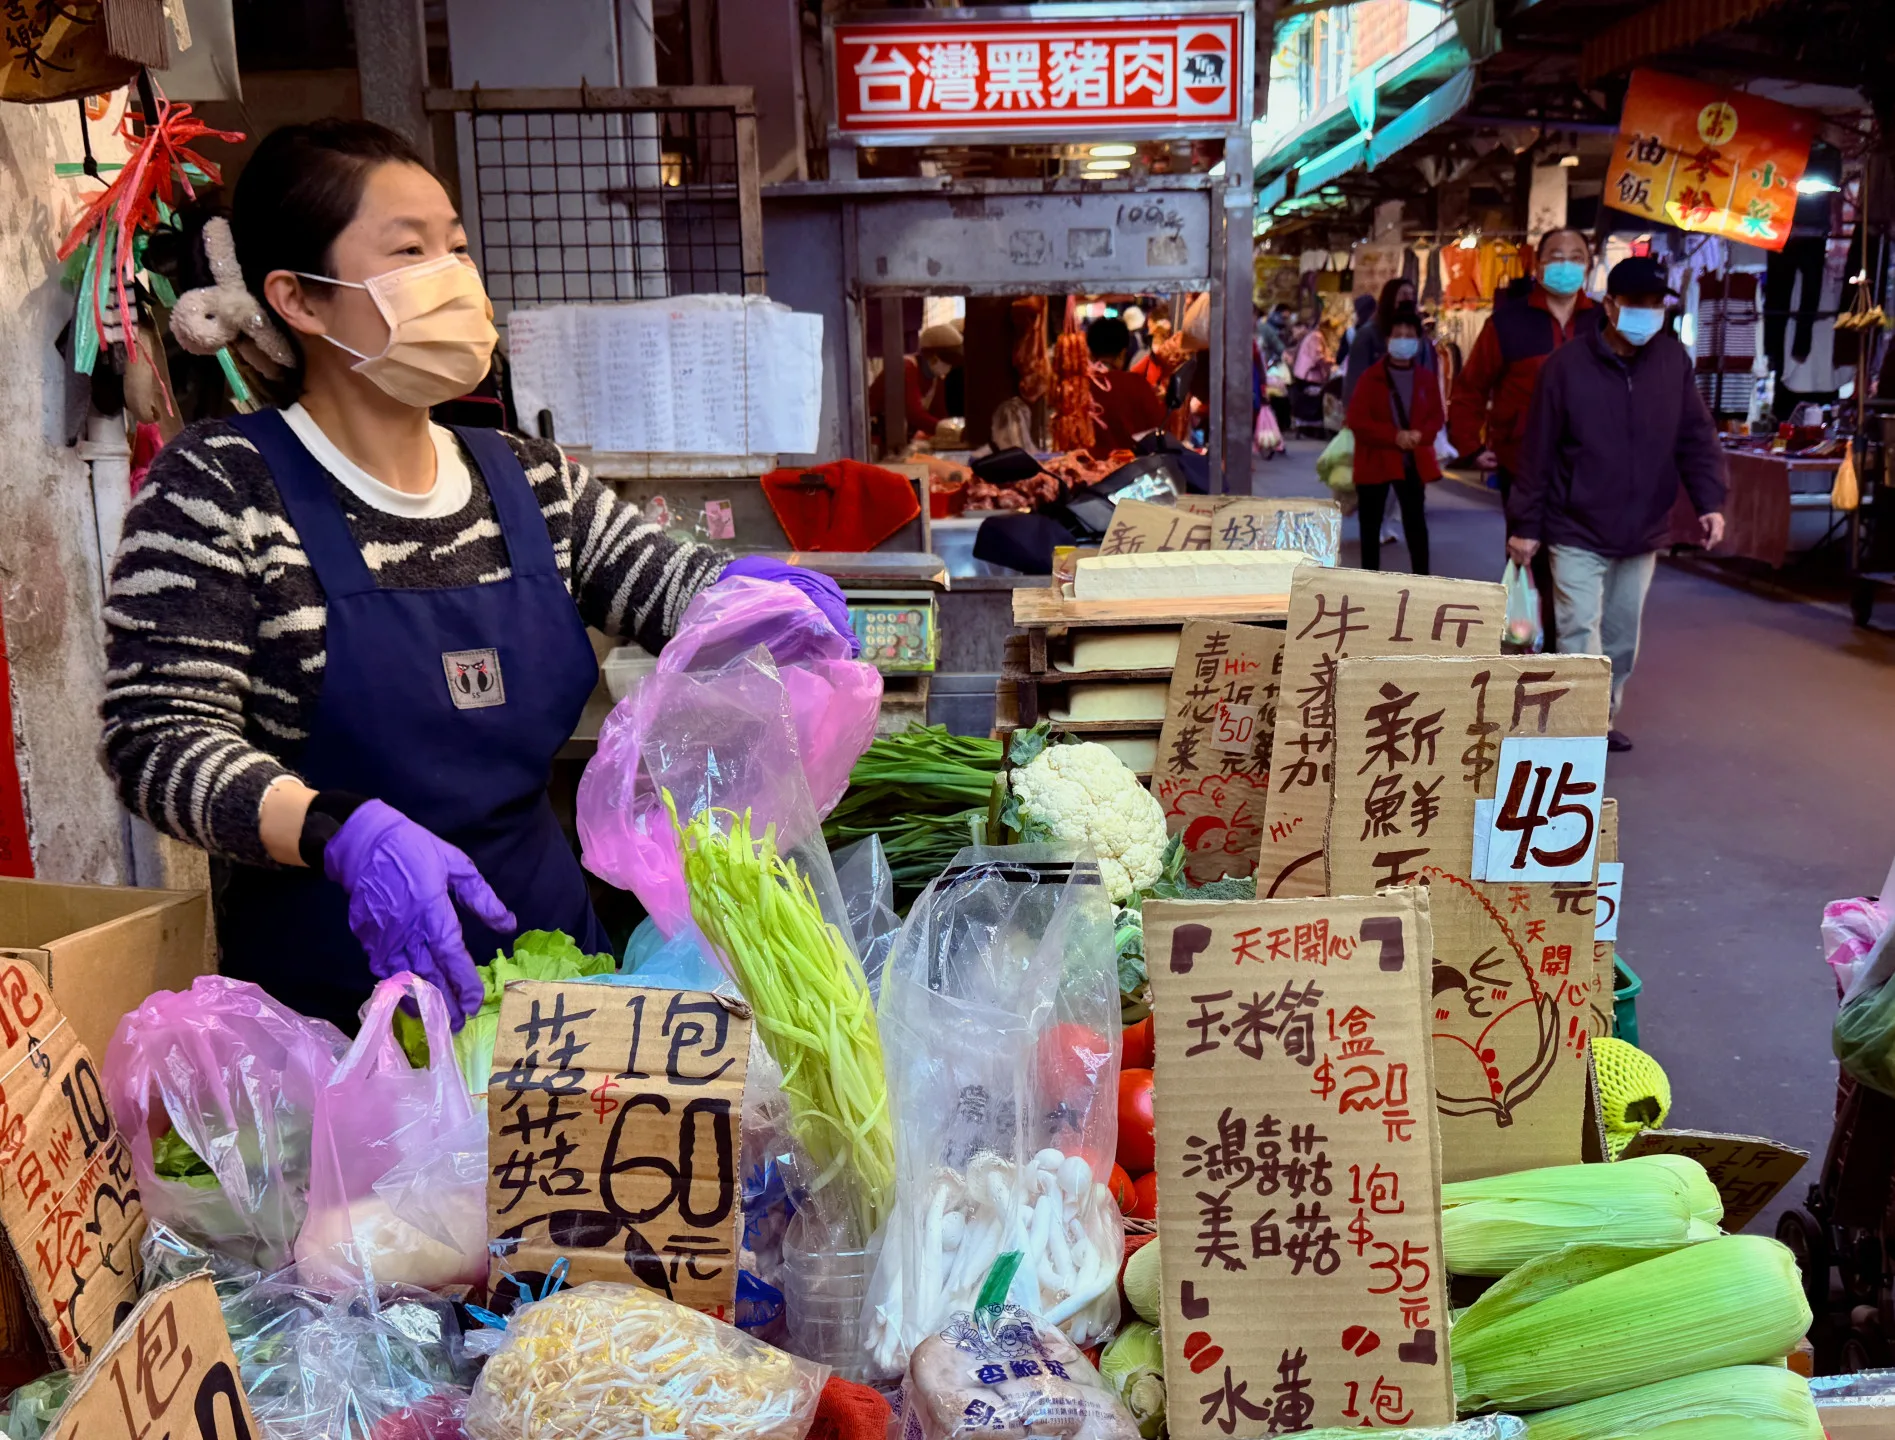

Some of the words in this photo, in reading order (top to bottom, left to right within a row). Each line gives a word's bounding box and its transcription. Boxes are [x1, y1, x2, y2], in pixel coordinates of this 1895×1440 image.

[854, 39, 1173, 112] 台灣黑豬肉
[1616, 133, 1667, 213] 油飯
[1741, 161, 1787, 238] 小菜
[1388, 588, 1485, 648] 1斤
[1167, 631, 1231, 775] 青花菜
[1495, 760, 1598, 870] 45
[1231, 918, 1357, 967] 天天開心
[1185, 979, 1324, 1067] 玉米筍
[488, 992, 597, 1215] 菇菇
[615, 992, 735, 1085] 1包
[1182, 1107, 1332, 1199] 鴻喜菇
[662, 1234, 731, 1284] 元
[1194, 1189, 1341, 1276] 美白菇
